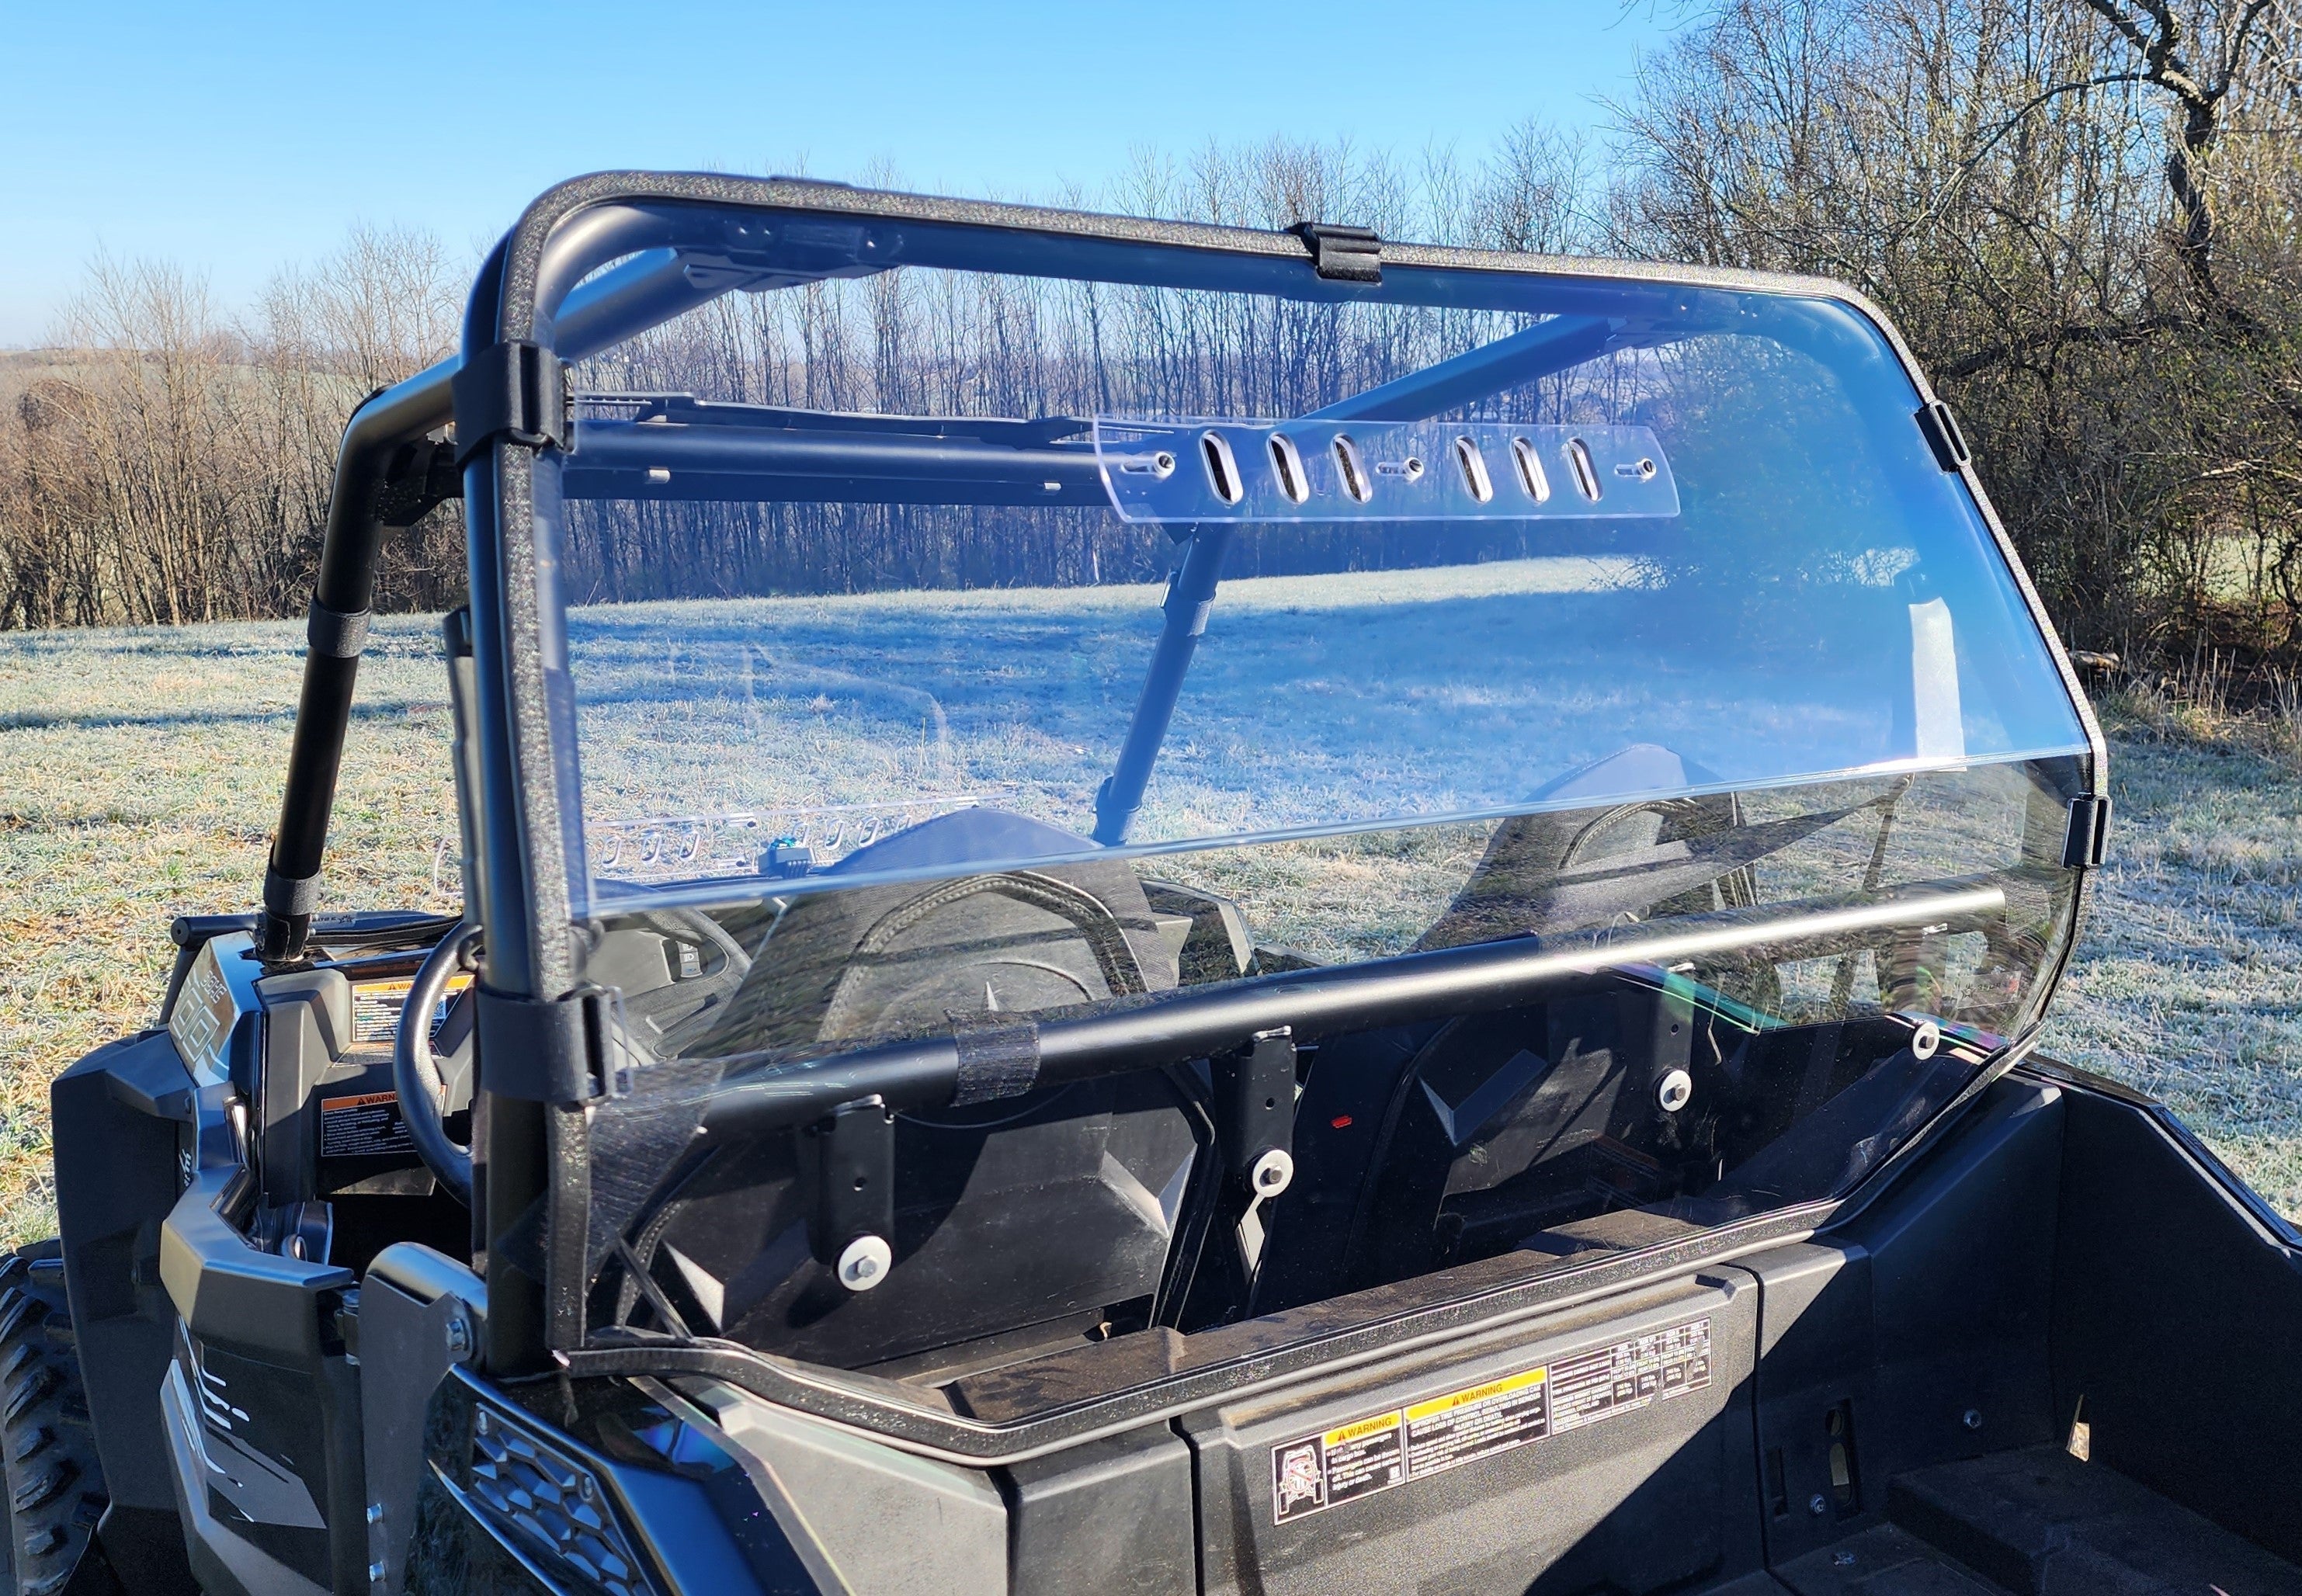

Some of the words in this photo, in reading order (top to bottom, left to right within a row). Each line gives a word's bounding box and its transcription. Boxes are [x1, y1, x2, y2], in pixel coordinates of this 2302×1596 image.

[366, 1094, 398, 1104] WARN
[1461, 1383, 1502, 1403] WARNING
[1348, 1417, 1391, 1437] WARNING
[1432, 1421, 1446, 1430] LOSS
